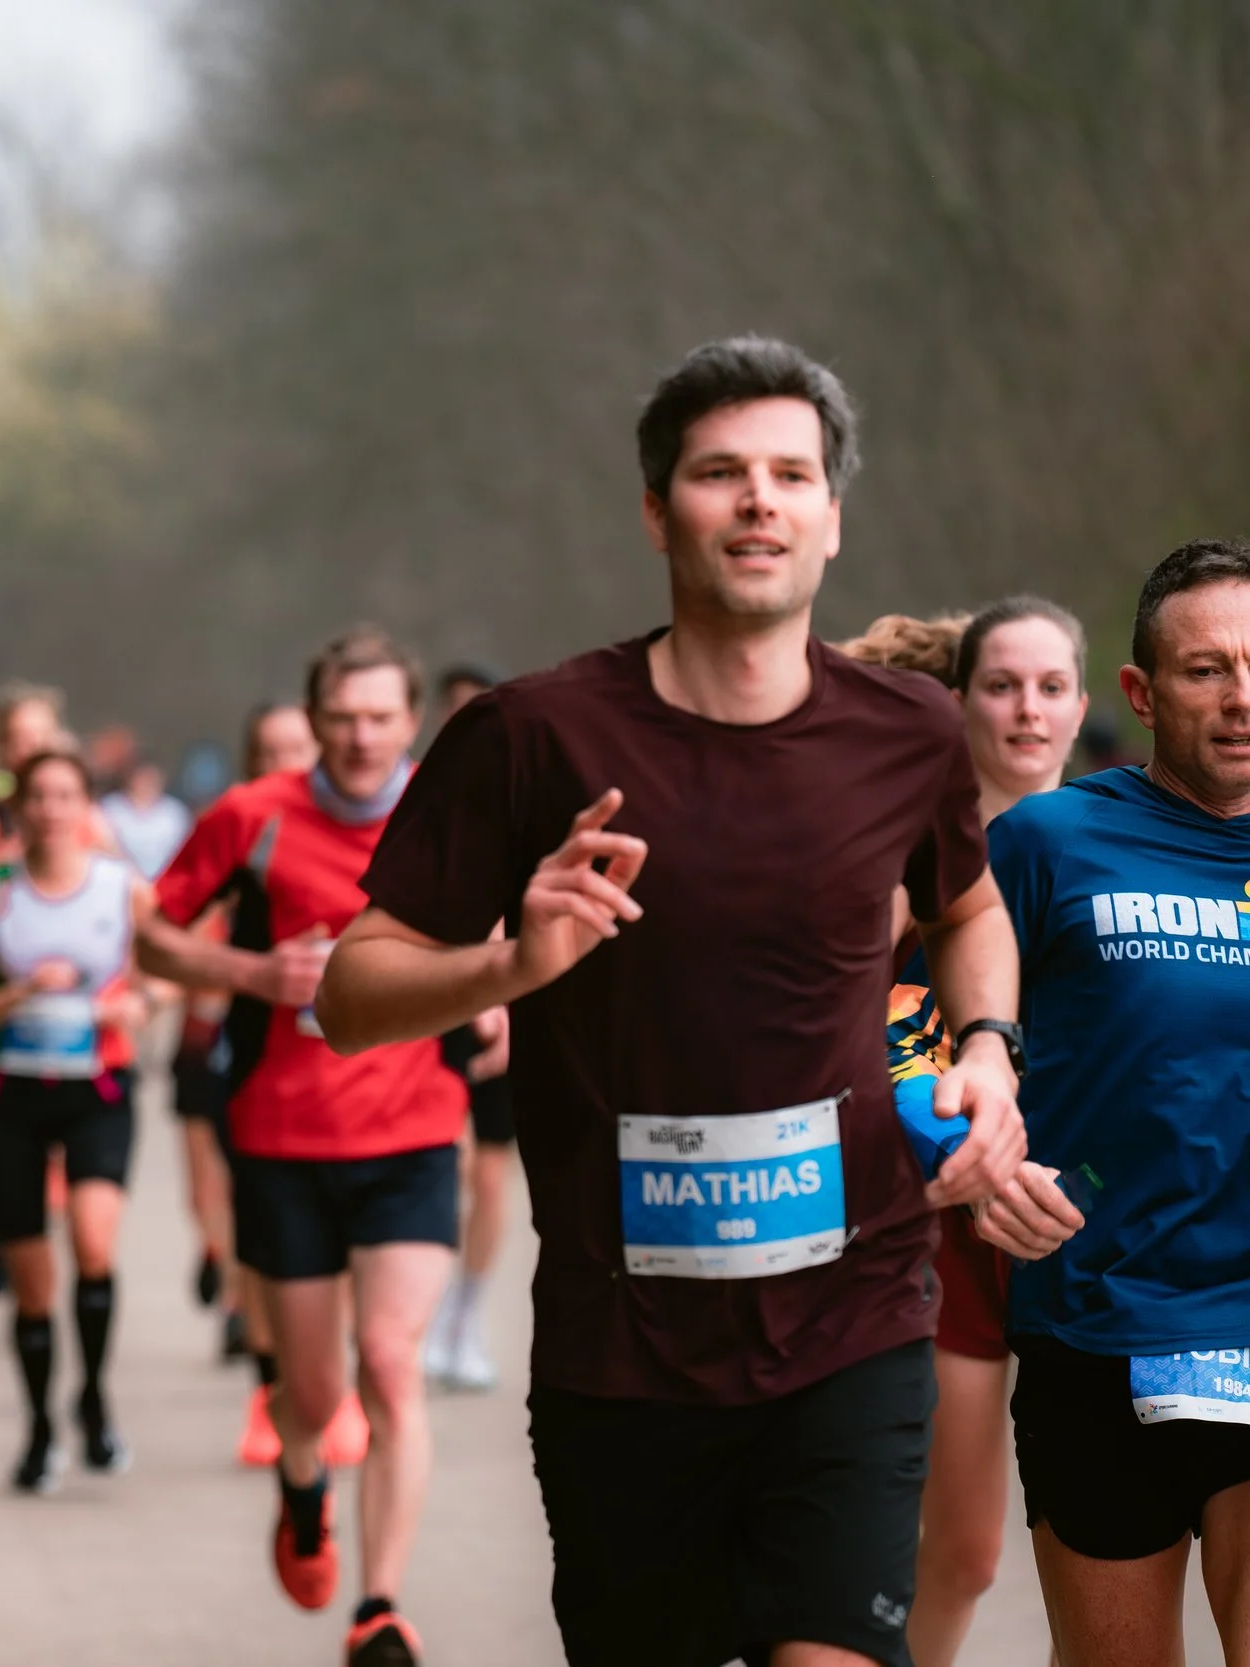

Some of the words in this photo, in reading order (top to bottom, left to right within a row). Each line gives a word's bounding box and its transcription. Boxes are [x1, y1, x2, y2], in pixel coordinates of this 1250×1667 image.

[1099, 939, 1190, 962] WORLD
[776, 1118, 810, 1141] 21K
[641, 1159, 822, 1206] MATHIAS
